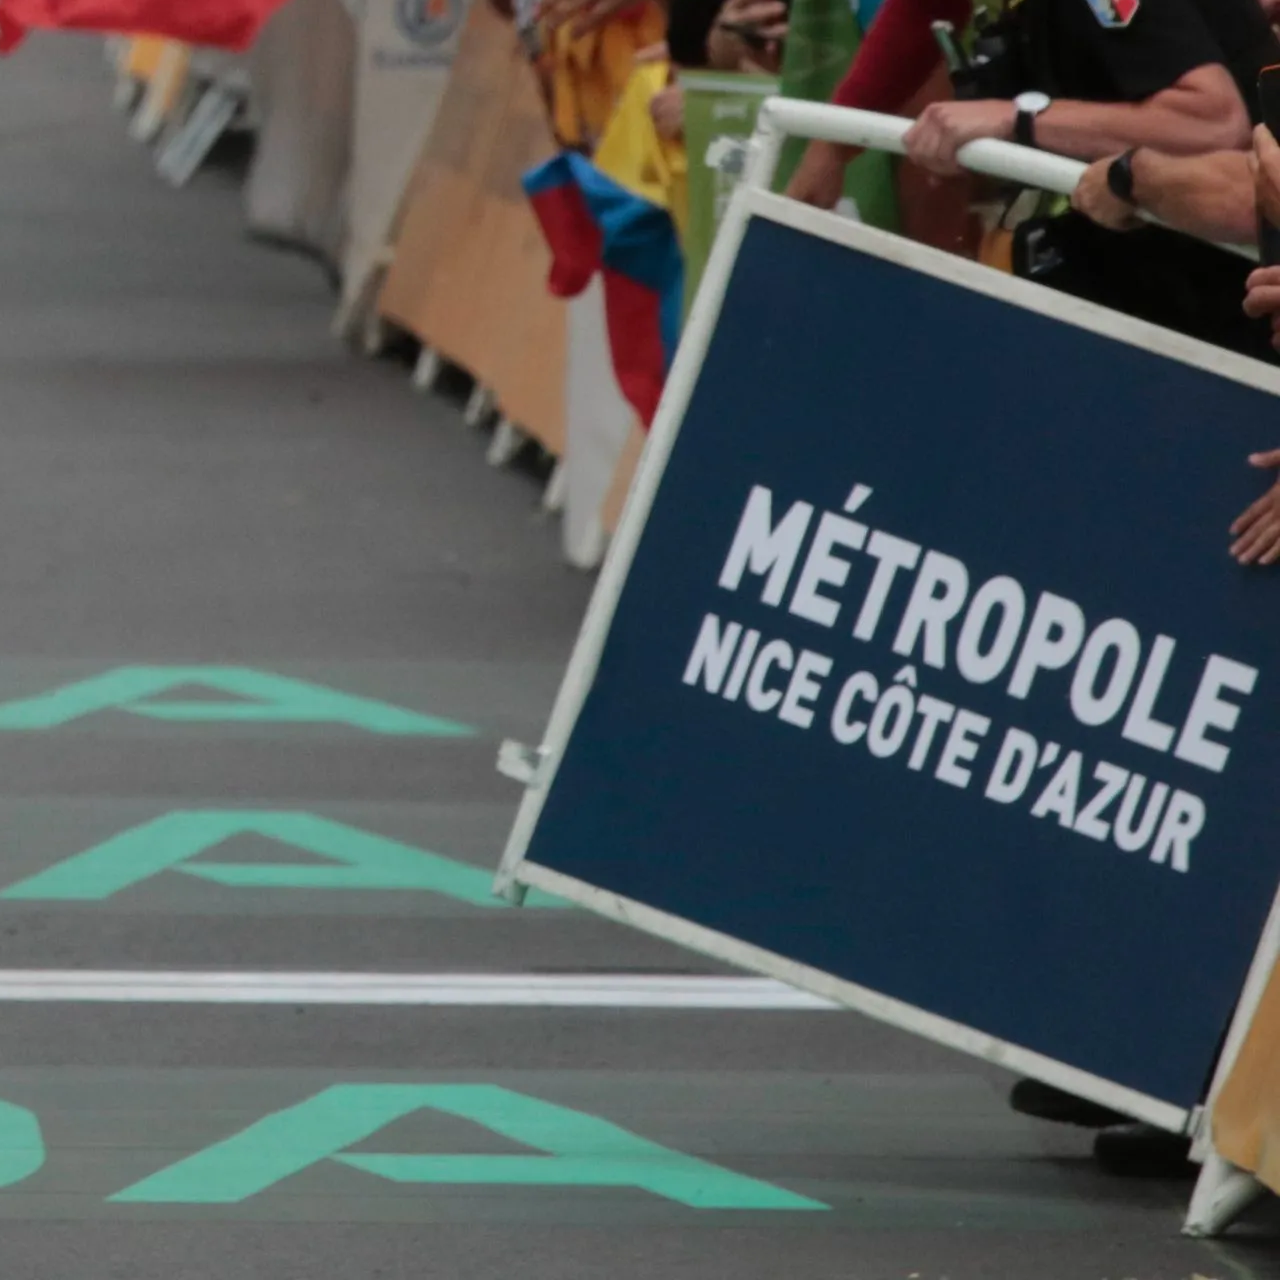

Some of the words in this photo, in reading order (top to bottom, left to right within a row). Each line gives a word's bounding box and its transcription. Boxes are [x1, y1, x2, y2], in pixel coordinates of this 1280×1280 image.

[683, 614, 834, 729] NICE
[831, 666, 991, 788] CÔTE
[718, 484, 1258, 772] MÉTROPOLE
